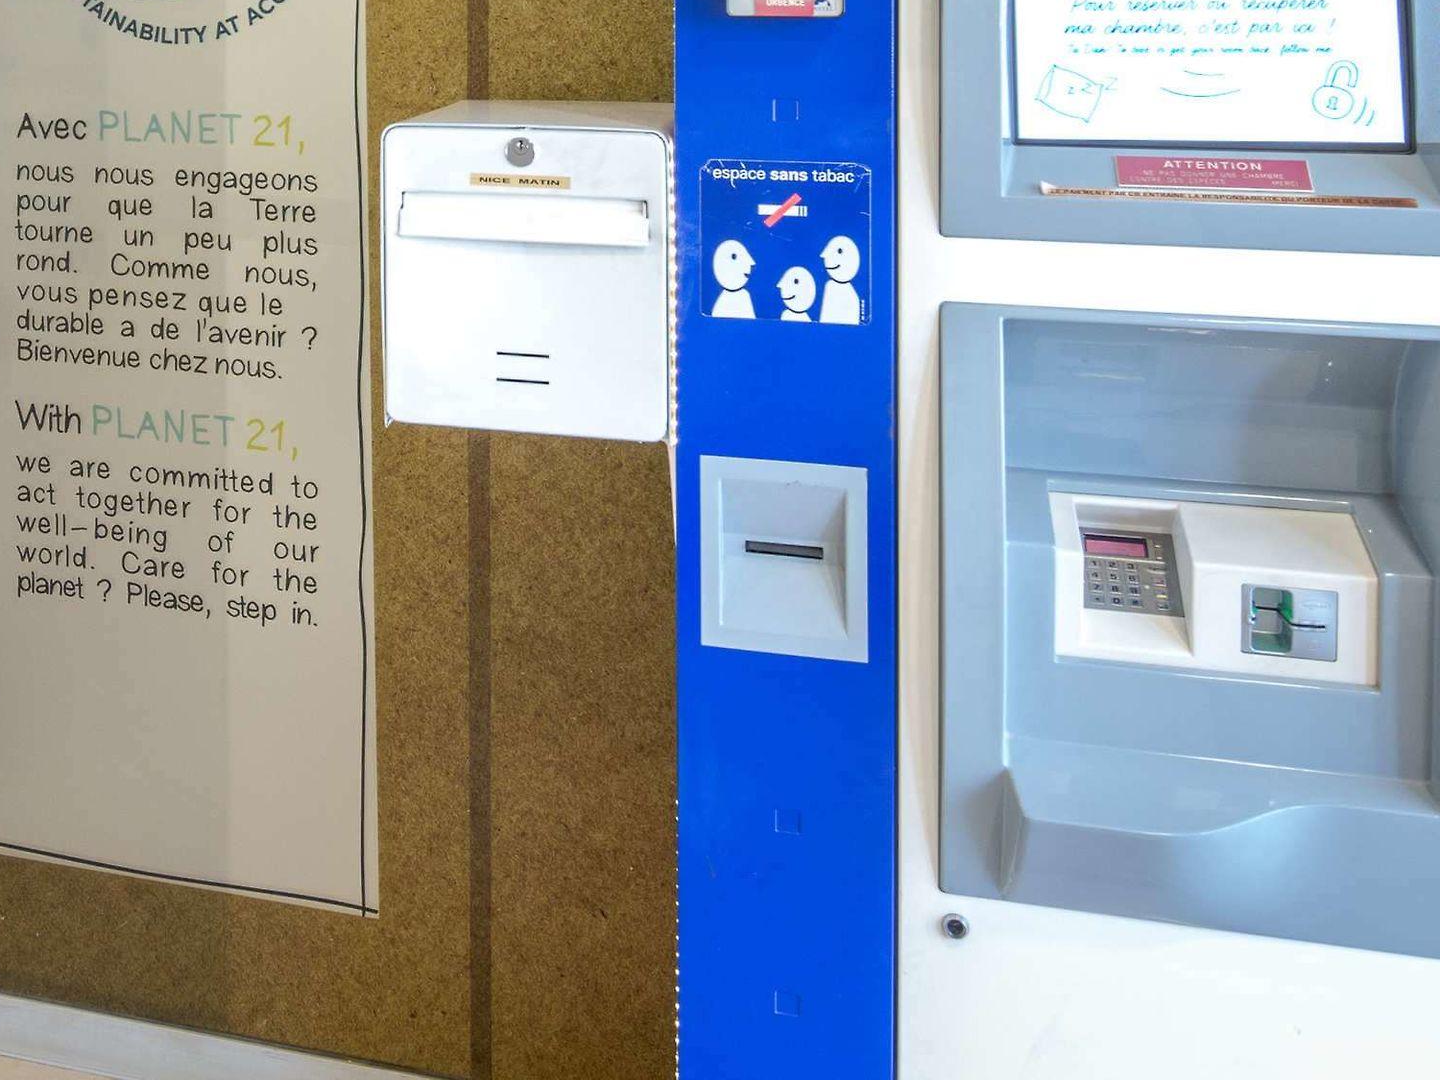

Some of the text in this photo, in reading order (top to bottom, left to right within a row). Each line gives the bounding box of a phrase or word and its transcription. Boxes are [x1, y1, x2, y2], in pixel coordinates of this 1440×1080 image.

[1207, 0, 1230, 10] ou
[214, 18, 240, 40] AT
[1064, 24, 1094, 34] ma
[1246, 22, 1283, 38] par
[16, 110, 306, 155] Avec PLANET 21,
[16, 163, 318, 195] nous nous engageons
[478, 176, 561, 187] NICE MATIN
[713, 166, 855, 184] espace sans tabac
[1164, 160, 1261, 170] ATTENTION
[16, 193, 317, 224] pour que la Terre
[15, 220, 318, 257] tourne un peu plus
[16, 252, 318, 291] rond. Comme nous,
[16, 284, 283, 316] vous pensez que le
[16, 310, 318, 351] durable a de l'avenir ?
[16, 339, 283, 379] Bienvenue chez nous.
[15, 400, 299, 461] With PLANET 21,
[16, 455, 319, 500] we are committed to
[16, 483, 318, 531] act together for the
[207, 531, 236, 555] of
[273, 540, 320, 564] our
[16, 542, 318, 595] world. Care for the
[16, 573, 319, 627] planet ? Please, step in.
